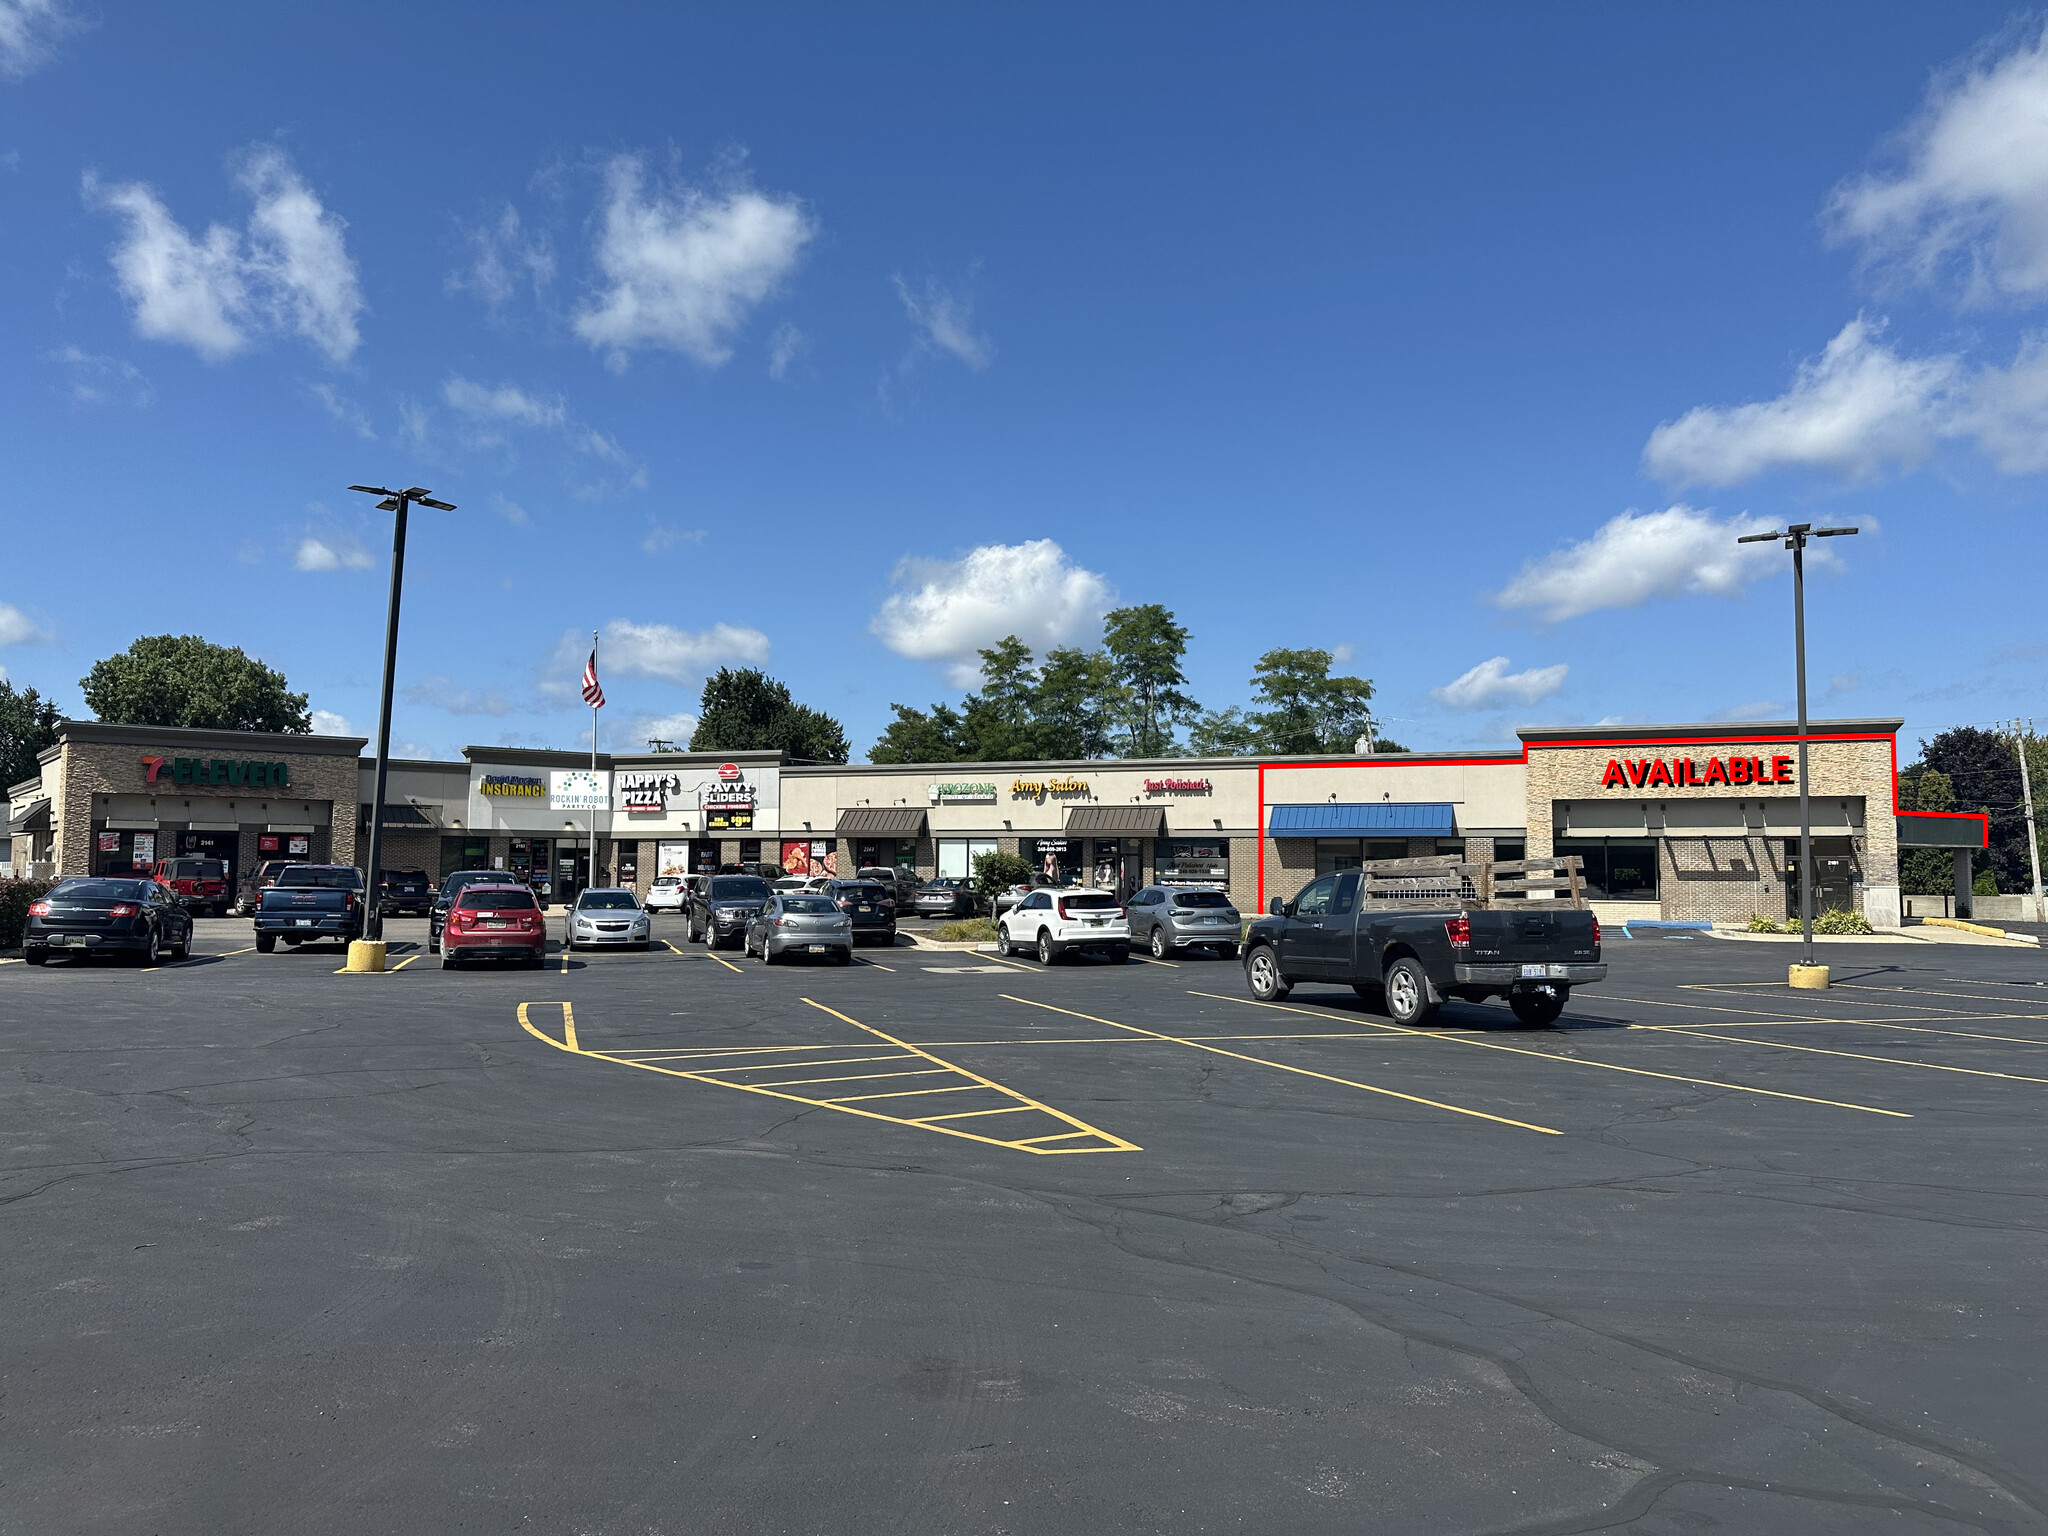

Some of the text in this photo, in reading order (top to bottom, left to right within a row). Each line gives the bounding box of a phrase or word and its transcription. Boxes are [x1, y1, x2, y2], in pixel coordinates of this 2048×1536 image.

[616, 773, 677, 789] HAPPY'S
[704, 782, 751, 793] SAVVY
[1009, 776, 1088, 799] Amy Salon
[1143, 778, 1204, 792] Just Polished
[481, 783, 546, 797] INSURANCE
[622, 789, 662, 804] PIZZA
[584, 795, 608, 804] ROBOT
[703, 793, 751, 803] SLIDERS
